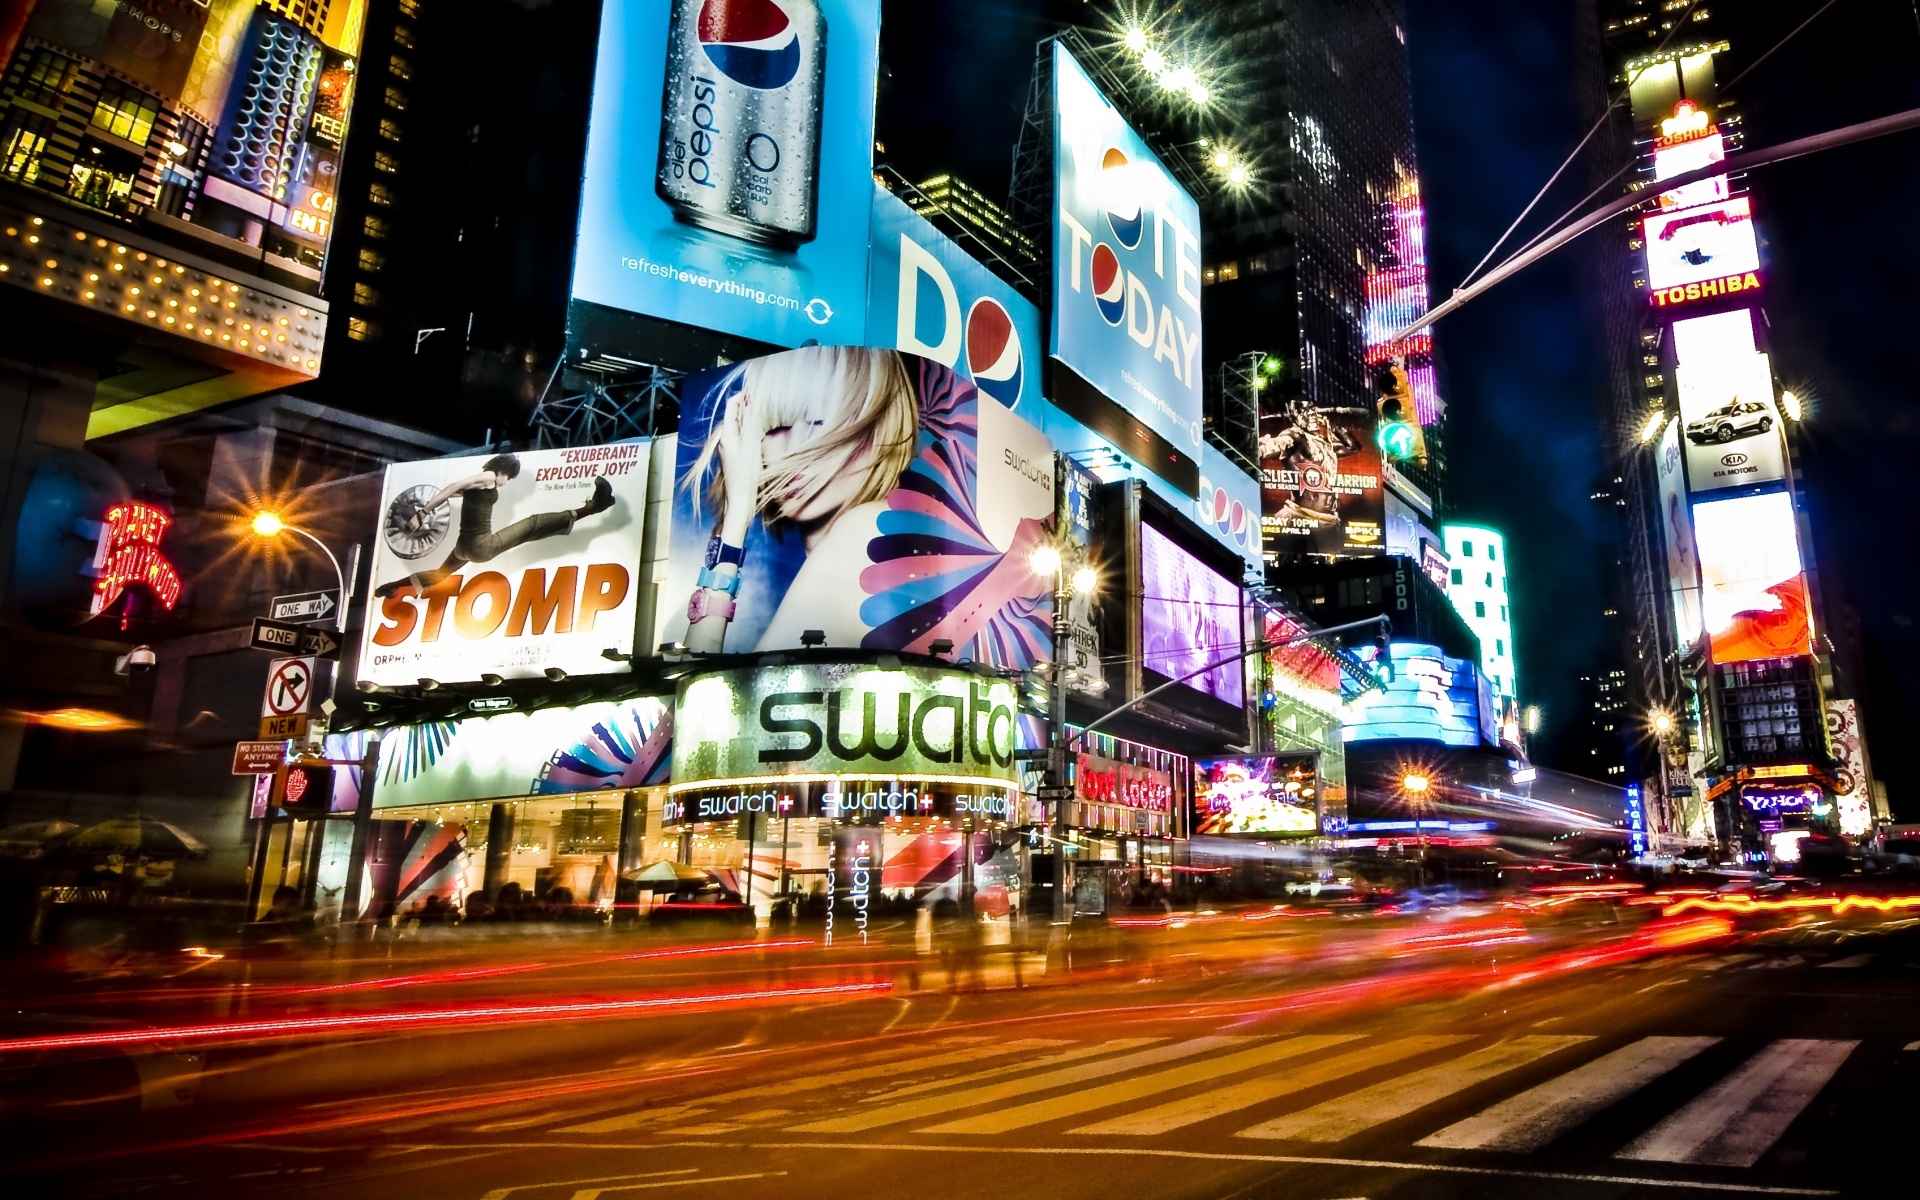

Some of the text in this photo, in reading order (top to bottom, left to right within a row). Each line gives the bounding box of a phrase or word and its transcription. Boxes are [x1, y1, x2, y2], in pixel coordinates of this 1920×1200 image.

[117, 1, 182, 42] SHOPS
[688, 75, 720, 189] pepsi
[672, 136, 686, 179] diet
[747, 180, 772, 196] carb
[752, 174, 769, 185] cal
[750, 191, 768, 206] sug
[621, 256, 799, 311] refresheverything.com
[1654, 272, 1760, 306] TOSHIBA
[1060, 207, 1199, 390] TODAY
[1004, 448, 1043, 487] swatch
[1725, 455, 1743, 464] KIA
[535, 463, 598, 482] EXPLOSIVE
[1326, 473, 1378, 489] WARRIOR
[1713, 465, 1758, 478] KIA MOTORS
[1197, 475, 1261, 557] GOOD
[1292, 518, 1319, 529] 10PM
[280, 599, 329, 616] ONE WAY
[372, 563, 629, 647] STOMP
[266, 629, 330, 650] ONE WAY
[269, 719, 297, 735] NEW
[252, 744, 285, 752] STANDING
[1669, 770, 1689, 778] KING
[1670, 777, 1689, 786] TUT
[698, 790, 776, 817] swatch
[821, 789, 917, 812] swatch
[955, 793, 1010, 815] swatch
